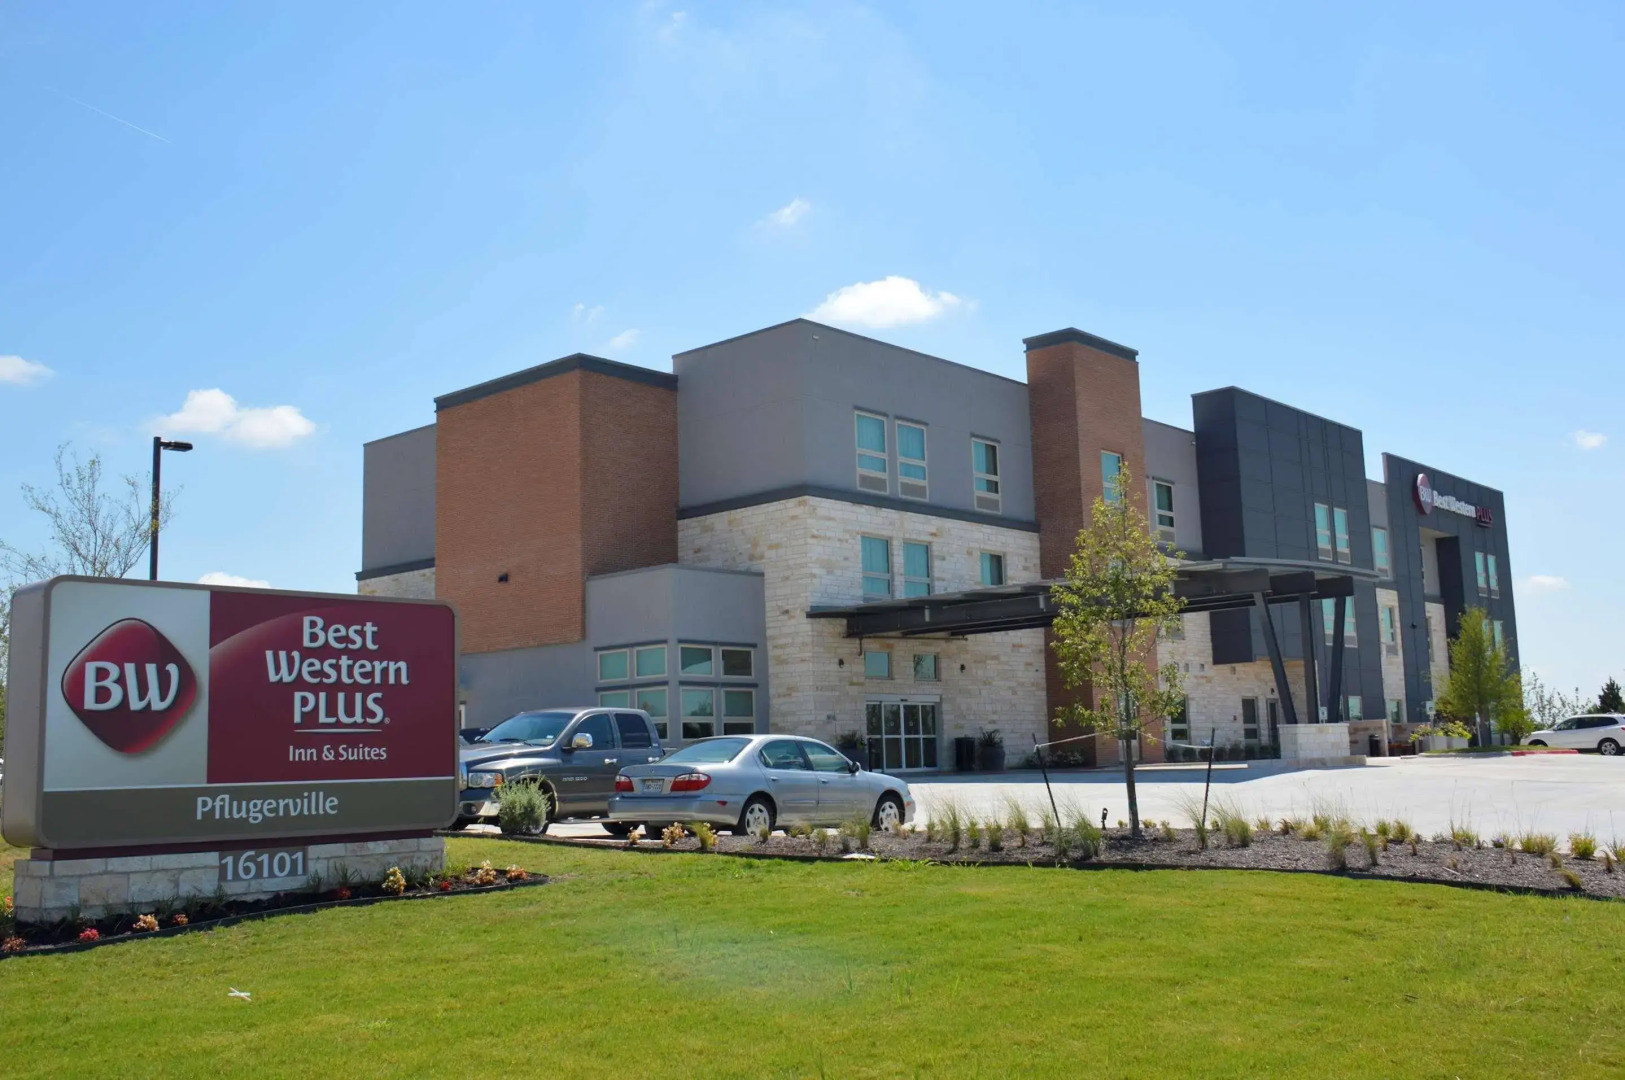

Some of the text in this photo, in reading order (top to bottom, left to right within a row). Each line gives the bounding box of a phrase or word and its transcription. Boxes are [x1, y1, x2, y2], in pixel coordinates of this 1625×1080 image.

[1432, 490, 1448, 510] Best
[1476, 506, 1493, 523] PLUS
[303, 616, 379, 650] Best
[265, 650, 410, 685] Western
[83, 661, 180, 711] BW
[293, 691, 385, 725] PLUS
[289, 744, 387, 761] Inn & Suites
[196, 791, 339, 824] Pflugerville
[220, 850, 304, 881] 16101
